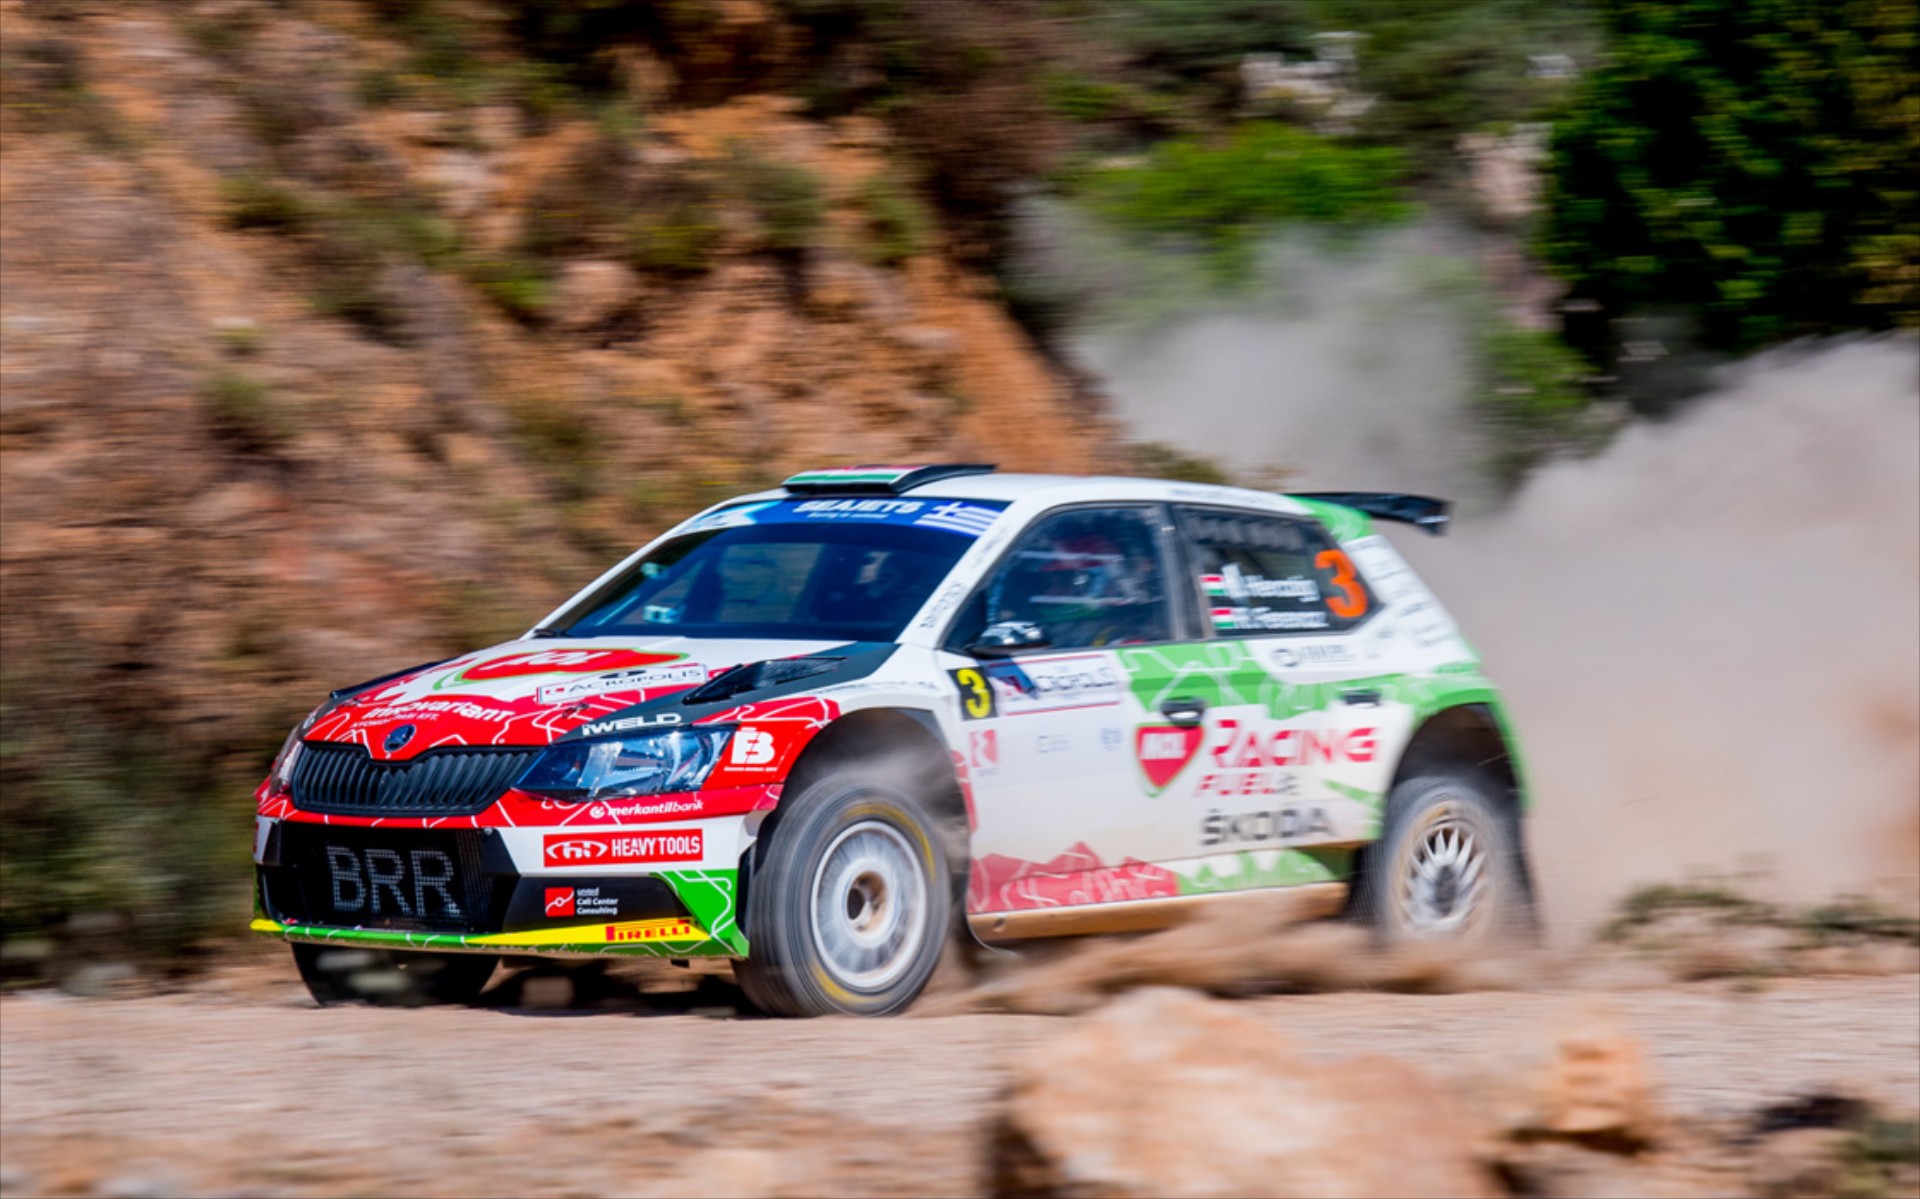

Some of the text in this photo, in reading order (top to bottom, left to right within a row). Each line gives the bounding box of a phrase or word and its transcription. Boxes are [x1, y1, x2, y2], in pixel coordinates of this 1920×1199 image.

[1315, 549, 1368, 618] 3
[568, 669, 702, 692] ACROPOLIS
[956, 668, 992, 718] 3
[581, 712, 682, 736] iWELD
[1210, 718, 1380, 769] RACING
[1200, 807, 1336, 846] ŠKODA
[611, 837, 657, 858] HEAVY
[657, 835, 701, 855] TOOLS
[326, 845, 460, 919] BRR
[576, 897, 619, 906] Call Center
[576, 906, 619, 916] Consulting
